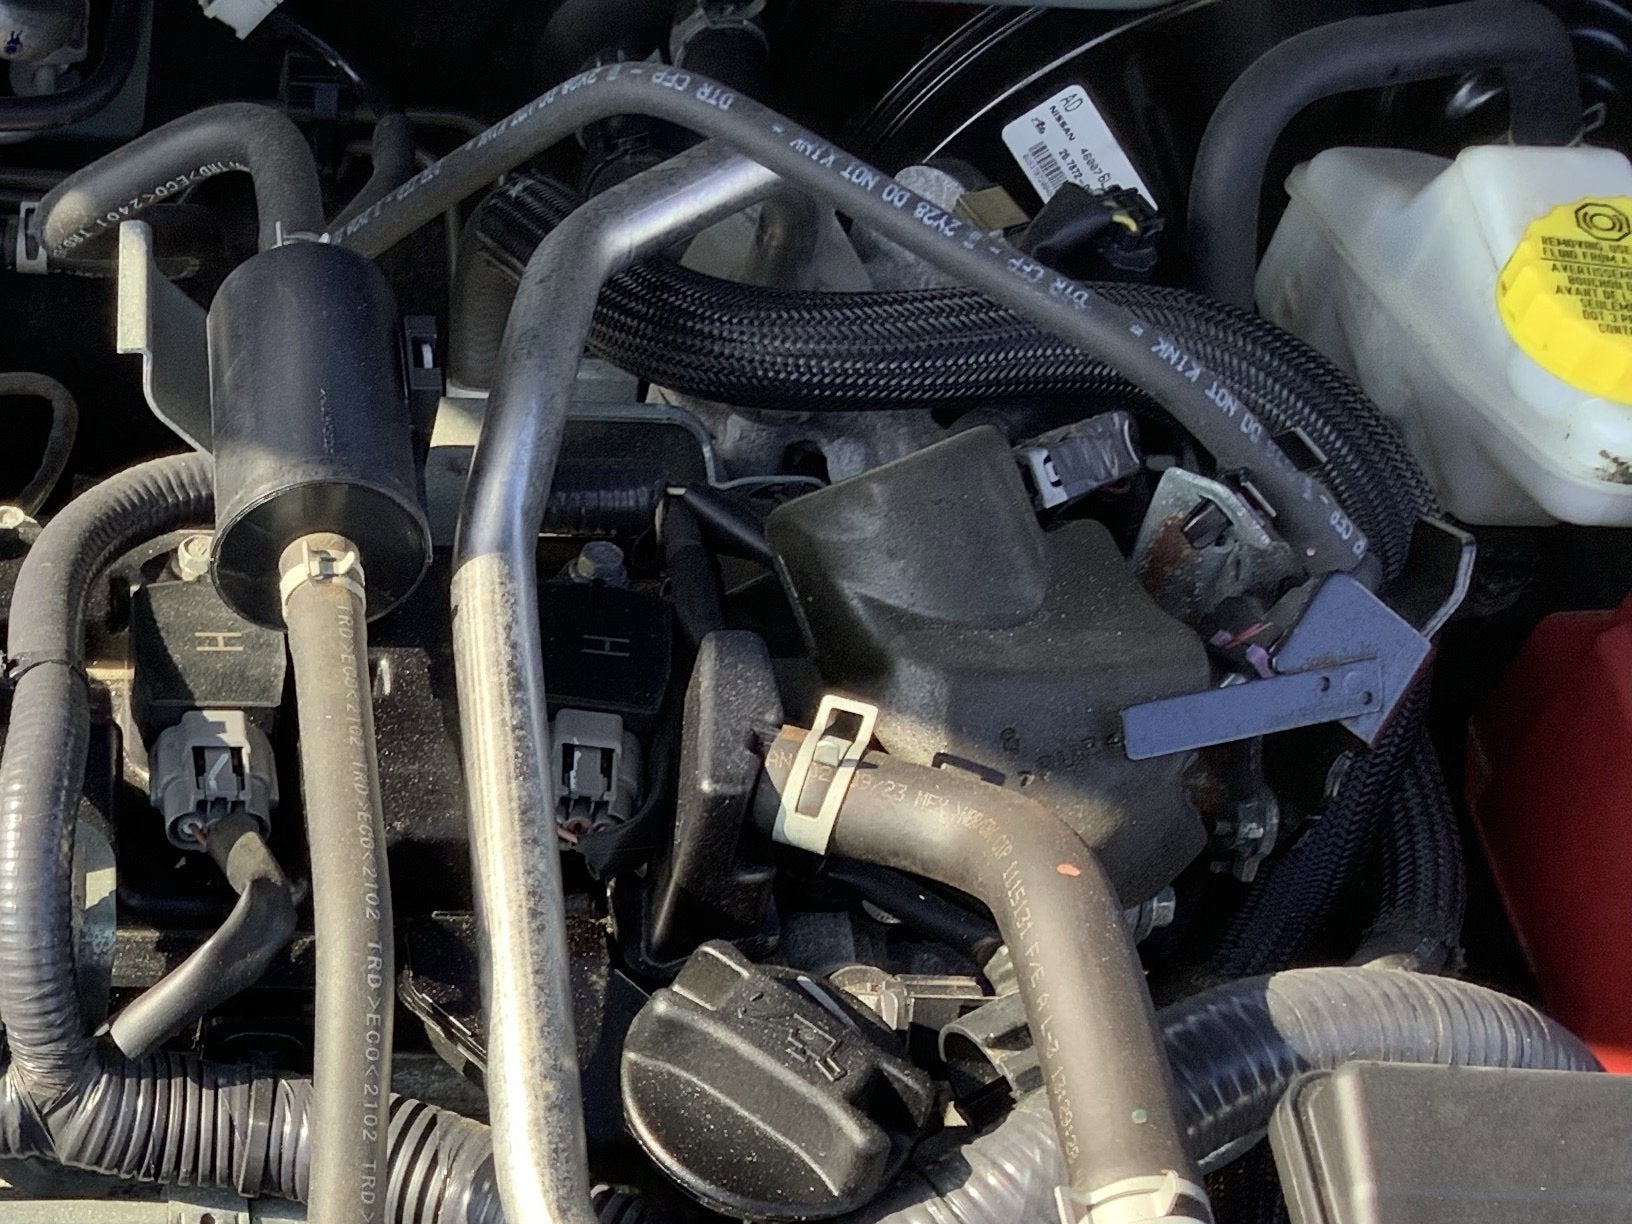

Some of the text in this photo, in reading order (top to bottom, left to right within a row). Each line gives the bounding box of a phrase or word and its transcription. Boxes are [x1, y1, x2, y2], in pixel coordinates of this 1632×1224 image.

[1059, 90, 1085, 115] AD
[1048, 104, 1077, 143] NISSAN
[840, 162, 880, 191] NOT
[1202, 379, 1242, 417] NOT
[194, 630, 243, 654] H
